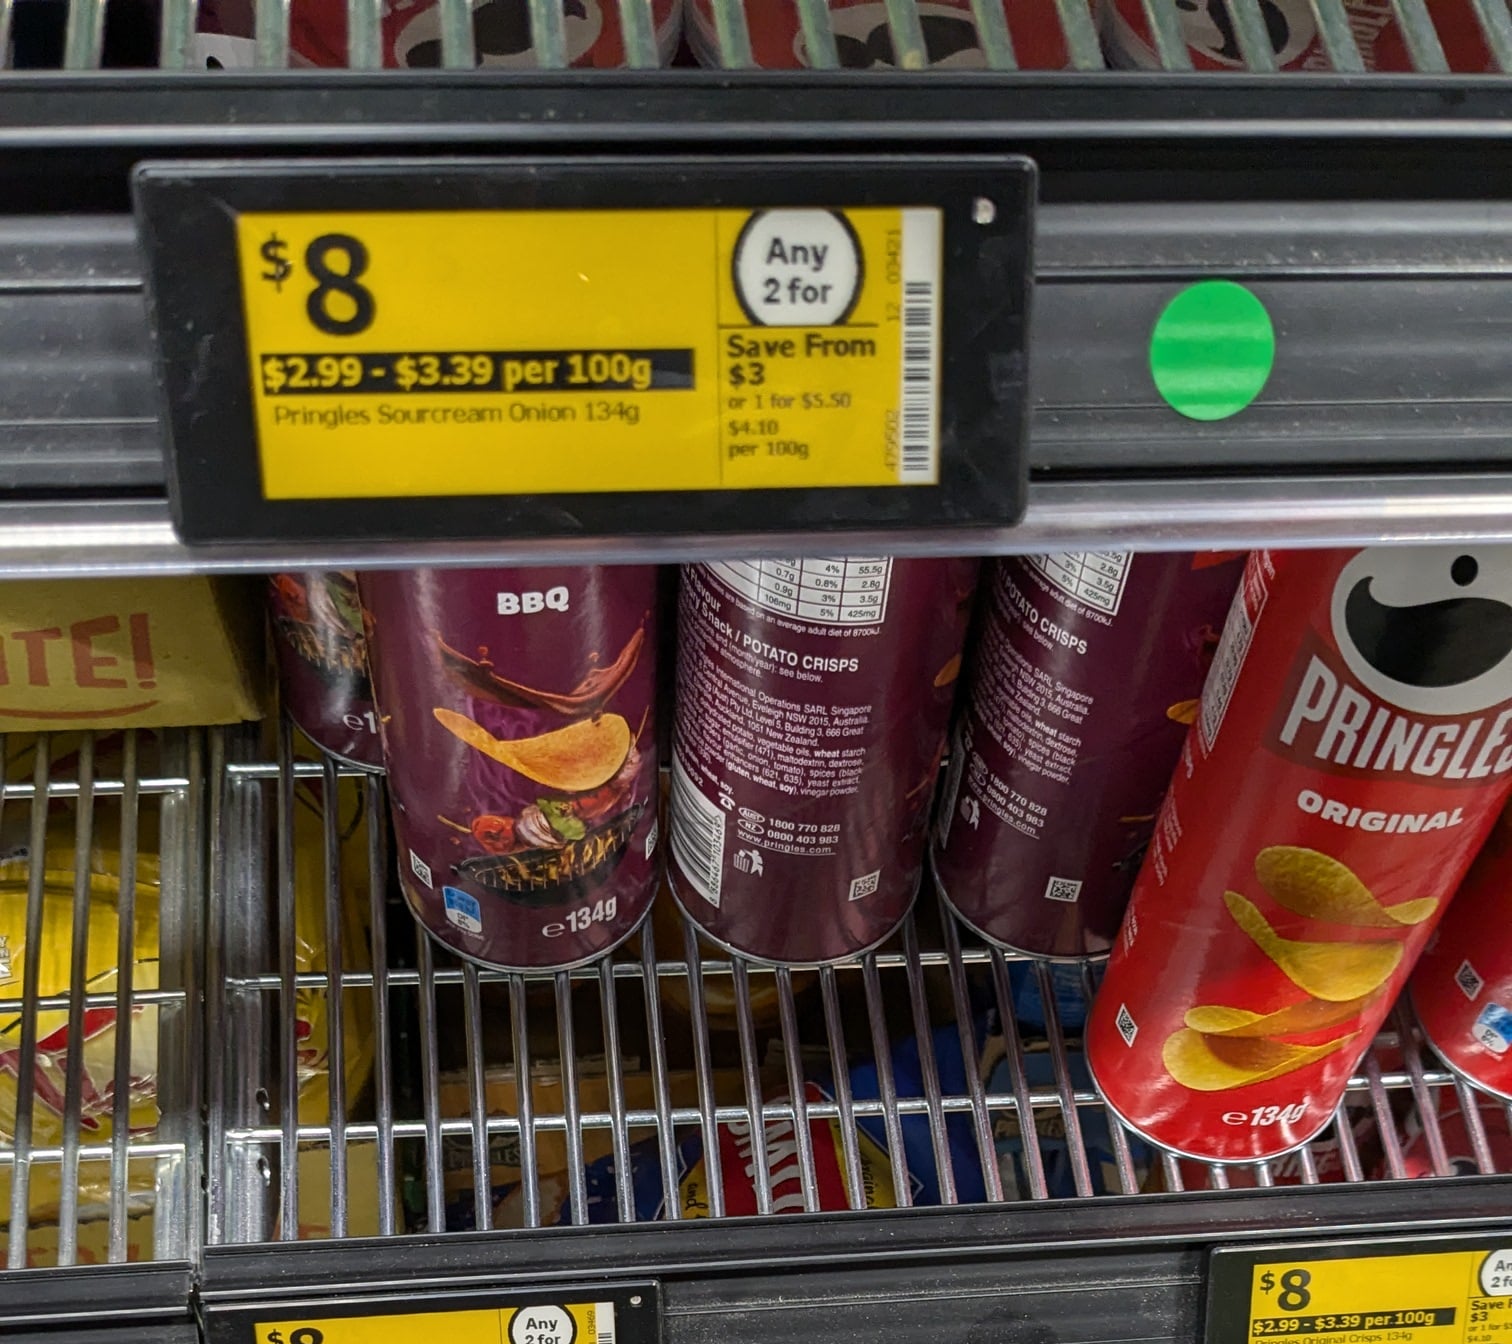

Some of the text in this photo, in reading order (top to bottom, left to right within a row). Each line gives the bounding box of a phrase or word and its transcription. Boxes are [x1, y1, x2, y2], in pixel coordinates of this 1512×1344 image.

[766, 237, 828, 271] Any
[763, 277, 832, 304] 2 for
[727, 333, 876, 359] Save From
[264, 353, 652, 392] $2.99 $3.39 per 100g
[729, 362, 765, 388] $3
[728, 396, 747, 410] or
[771, 394, 794, 409] for
[802, 391, 851, 410] $5.50
[275, 401, 640, 428] Pringles Sourcream Onion 134g
[729, 420, 778, 437] $4.10
[729, 440, 809, 460] per 100g
[776, 567, 881, 590] 0.7g 0.8% 2.8g
[825, 564, 883, 576] 4% 55.5g
[496, 586, 570, 616] BBQ
[774, 582, 793, 597] 0.9g
[702, 601, 859, 673] Snack POTATO CRISPS
[1040, 617, 1088, 655] CRISPS
[0, 612, 158, 690] TE!
[1297, 789, 1464, 834] ORIGINAL
[767, 829, 839, 845] 0800 403 983
[769, 818, 841, 833] 1800 770 828
[1490, 1276, 1500, 1288] 2
[1470, 1311, 1489, 1323] $3
[1471, 1300, 1504, 1311] Save
[525, 1316, 559, 1335] Any
[1253, 1311, 1435, 1336] $2.99 $3.39 per 100g
[1349, 1331, 1383, 1344] Crisps
